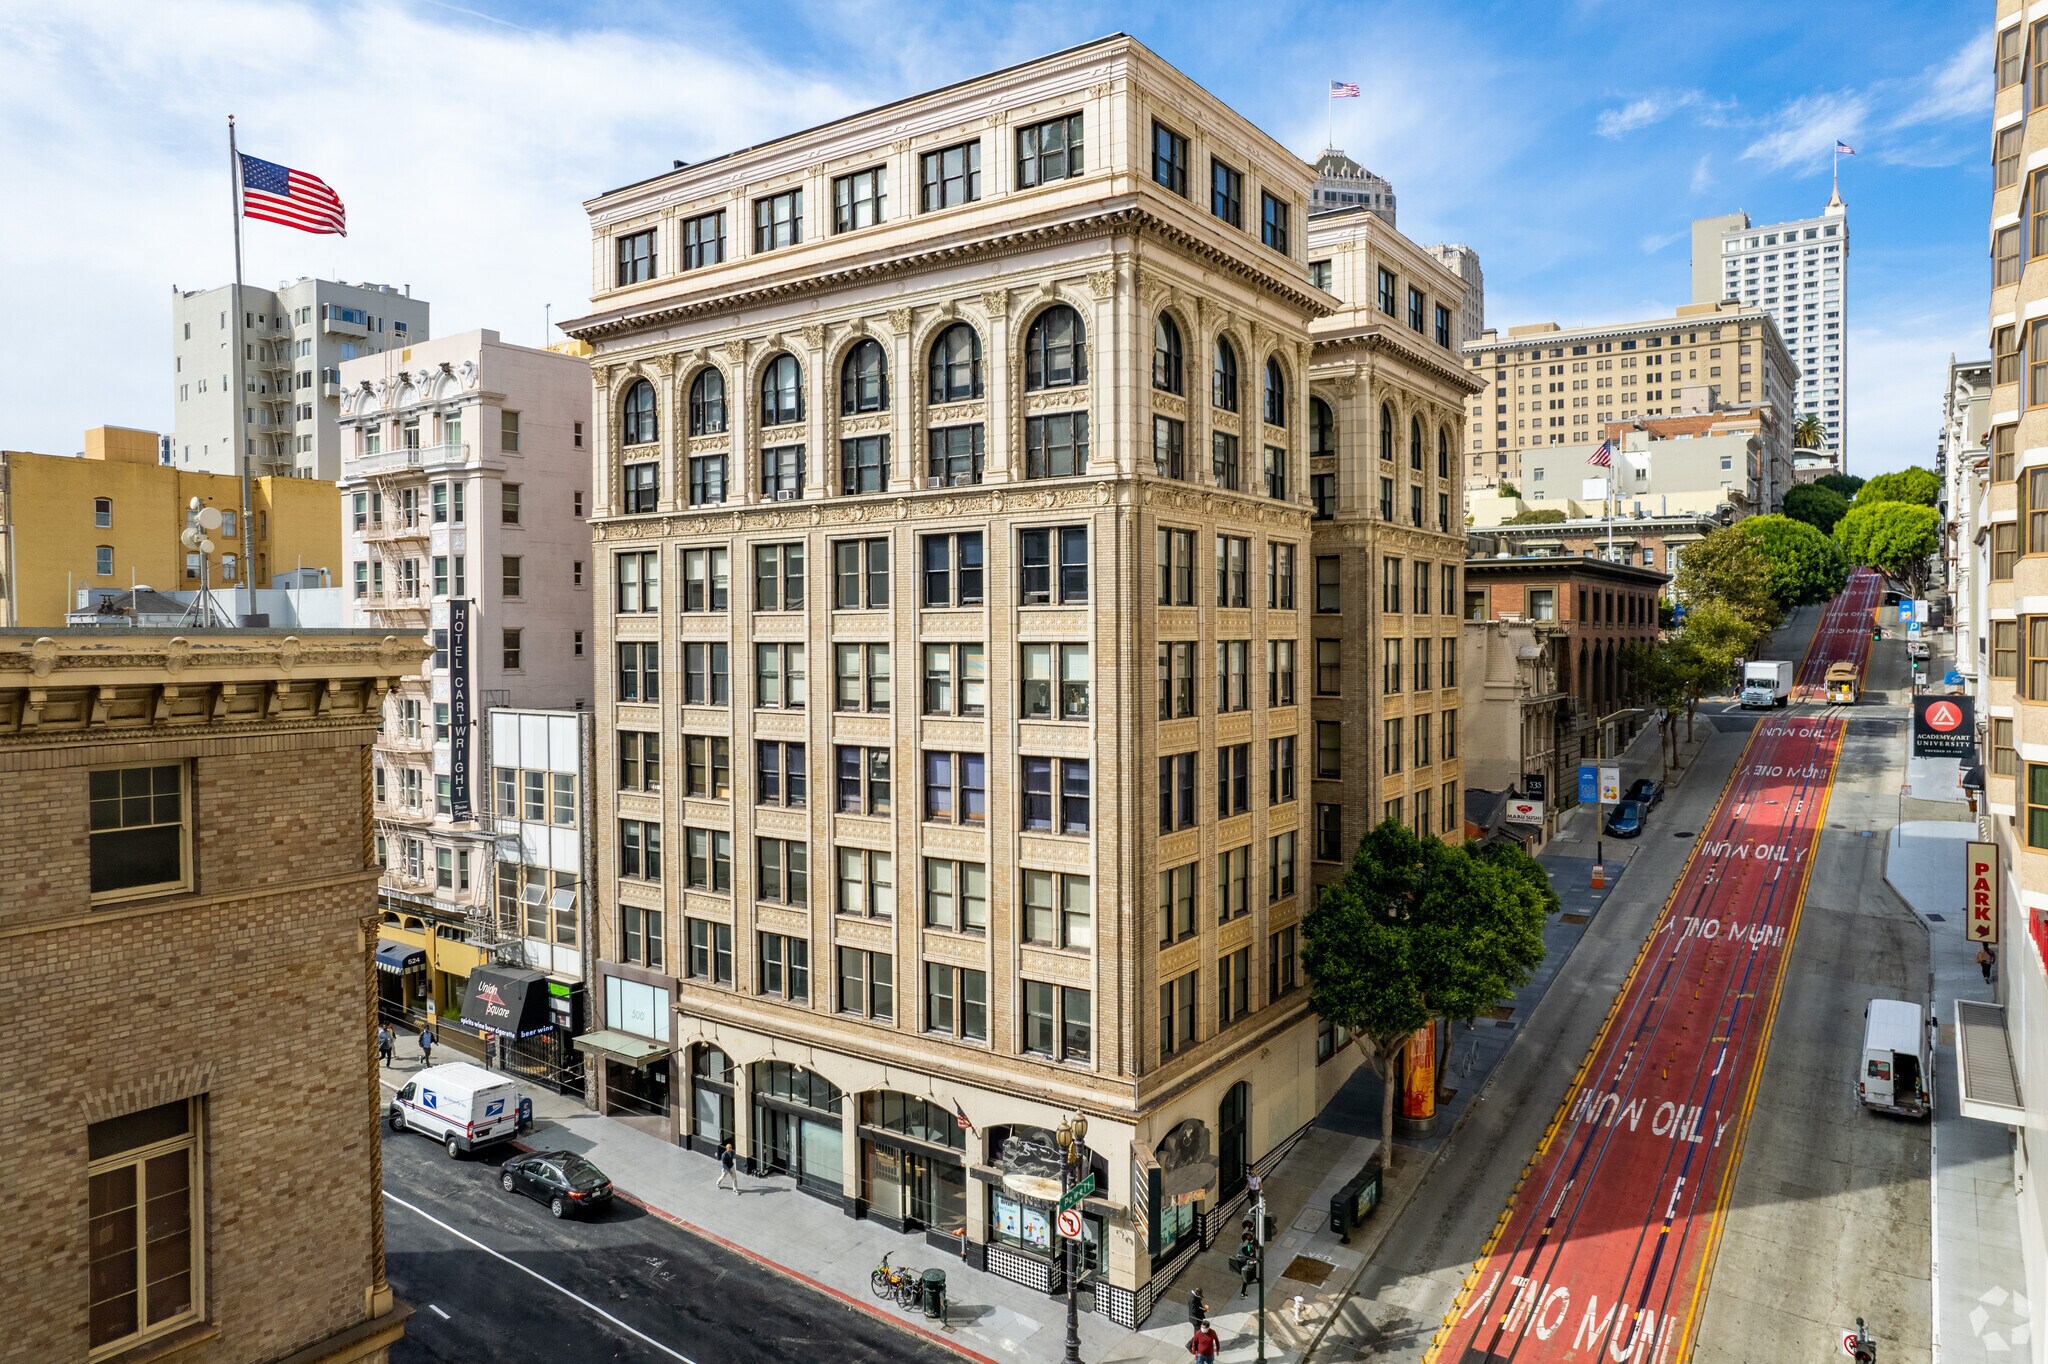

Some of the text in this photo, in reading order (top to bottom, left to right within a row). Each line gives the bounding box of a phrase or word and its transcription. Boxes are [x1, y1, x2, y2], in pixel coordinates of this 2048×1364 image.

[1909, 622, 1918, 631] P
[454, 609, 467, 797] HOTEL CARTWRIGHT
[1760, 727, 1796, 737] MUNI
[1799, 728, 1839, 739] ONLY
[1916, 740, 1971, 748] UNIVERSITY
[1739, 764, 1783, 777] ONLY
[1786, 766, 1827, 779] MUNI
[1529, 781, 1542, 789] 535
[1701, 841, 1749, 860] MUNI
[1754, 844, 1808, 863] ONLY
[1973, 862, 1992, 921] PARK
[1659, 915, 1720, 939] ONLY
[1728, 921, 1786, 947] MUNI
[407, 957, 421, 965] 524
[478, 980, 498, 996] Union
[487, 1002, 510, 1018] Square
[631, 1009, 645, 1021] 500
[460, 1017, 474, 1027] spirits
[474, 1019, 485, 1030] wine
[484, 1021, 496, 1033] beer
[520, 1024, 554, 1039] beer wine
[1569, 1087, 1647, 1132] MUNI
[1652, 1101, 1736, 1148] ONLY
[1462, 1271, 1570, 1341] ONLY
[1572, 1295, 1677, 1364] MUNI
